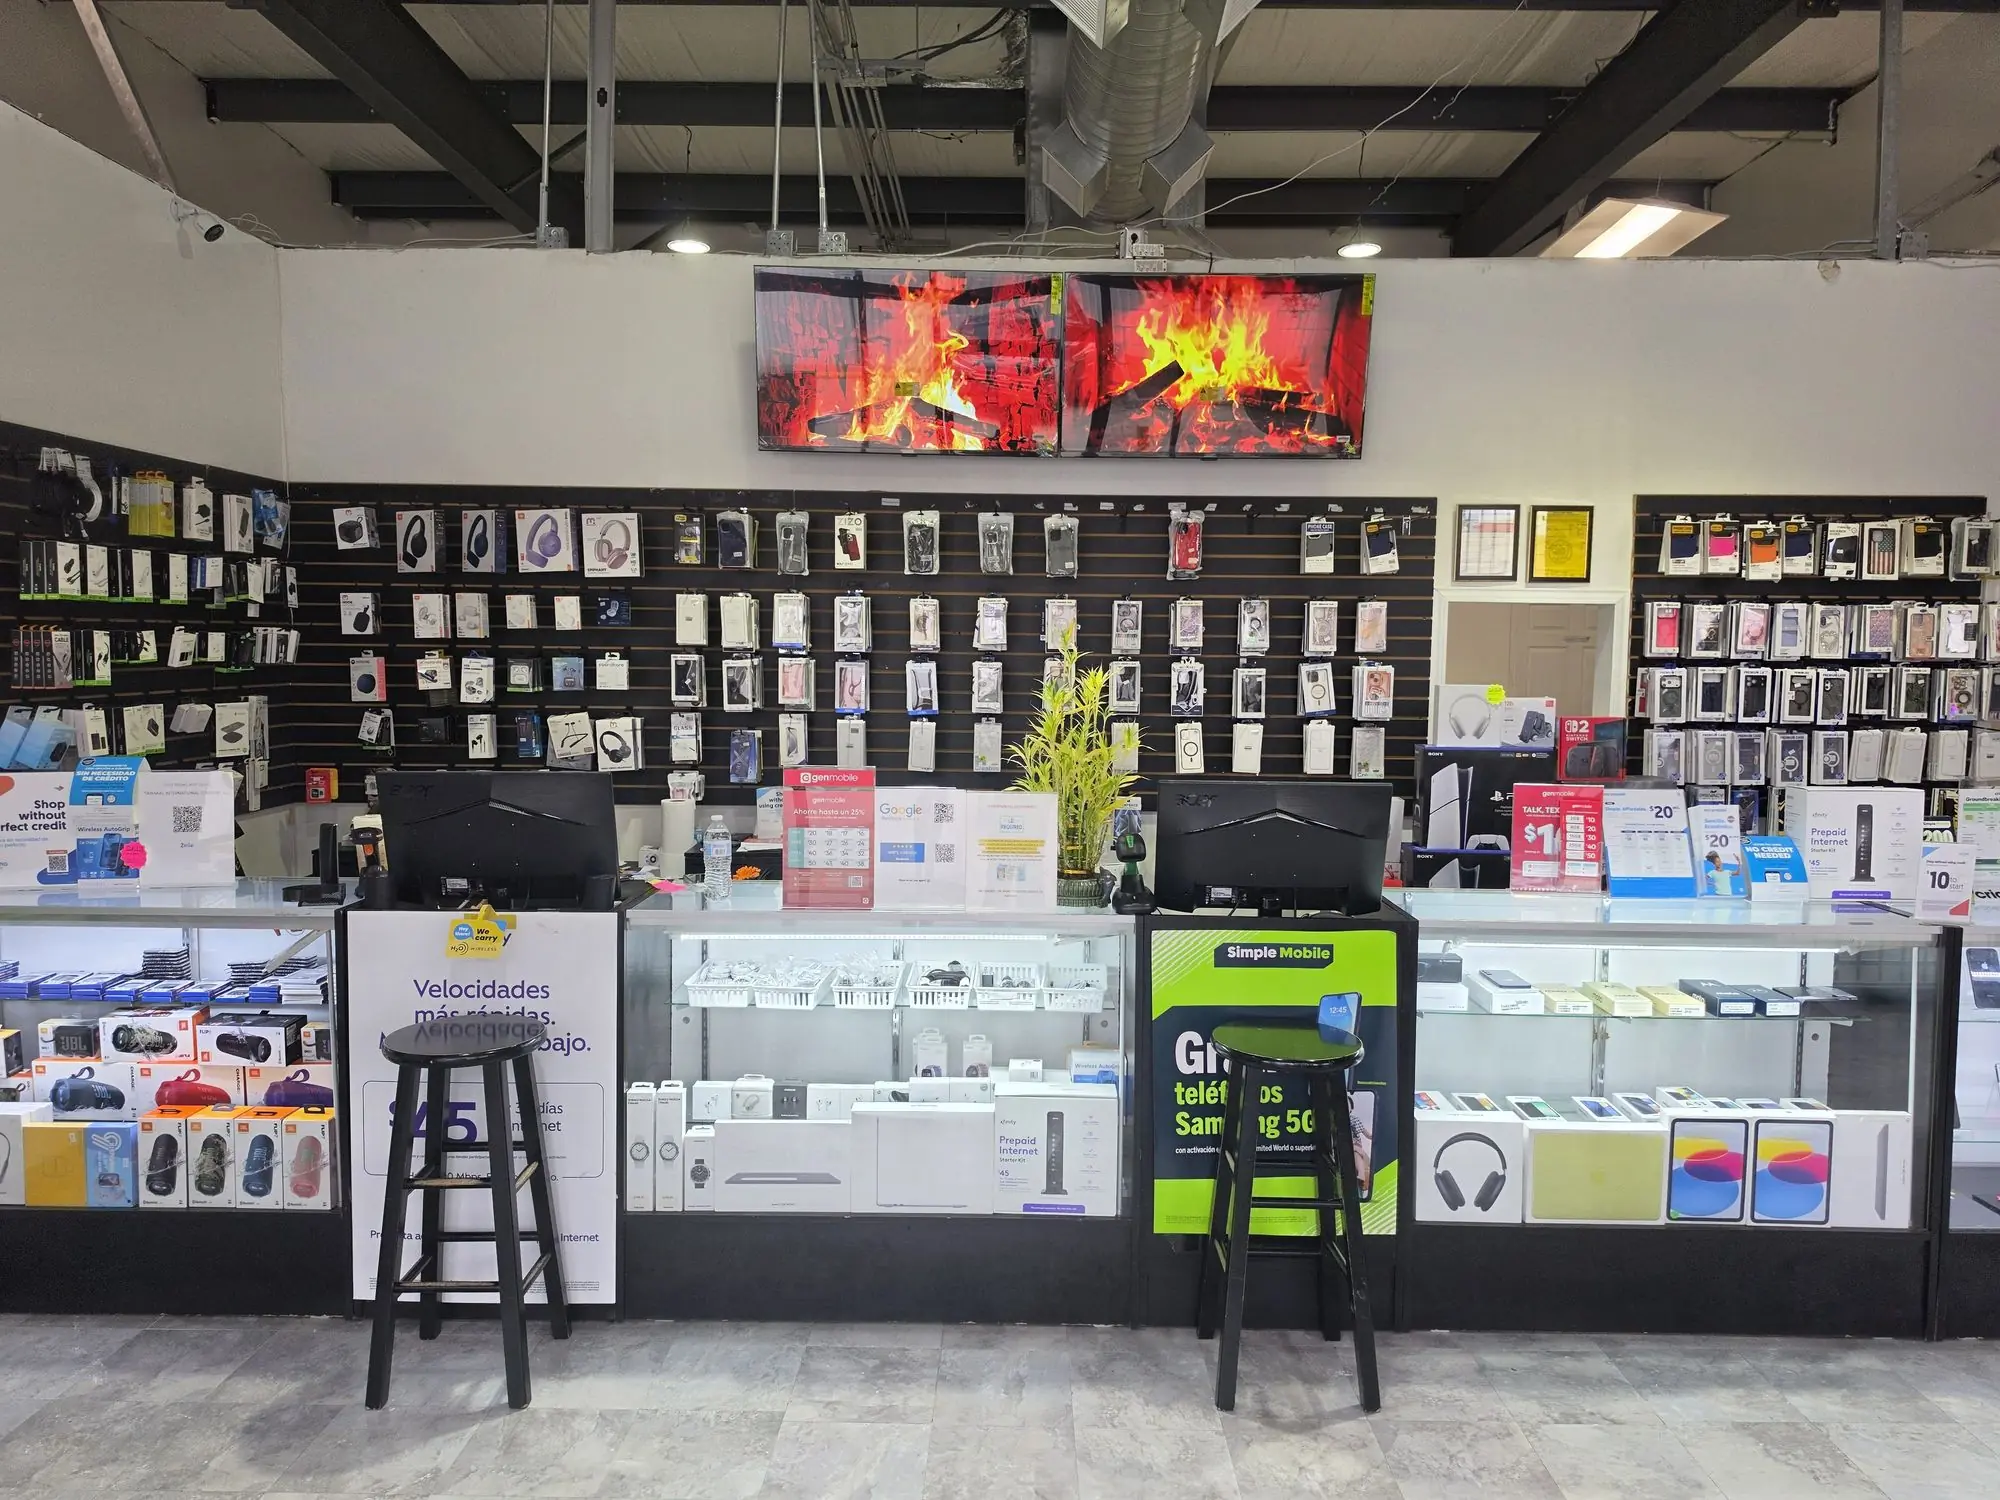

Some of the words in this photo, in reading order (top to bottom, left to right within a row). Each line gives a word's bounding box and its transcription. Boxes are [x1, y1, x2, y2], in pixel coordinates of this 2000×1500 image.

[838, 518, 862, 526] ZIZO
[1579, 720, 1589, 732] 2
[812, 774, 858, 783] genmobile
[34, 800, 65, 811] Shop
[880, 803, 922, 818] Google
[1523, 806, 1544, 814] TALK,
[1546, 806, 1560, 814] TEX
[19, 811, 66, 821] without
[1649, 806, 1673, 819] $20
[1, 822, 28, 832] rfect
[31, 821, 67, 831] credit
[1811, 828, 1847, 837] Prepaid
[1705, 834, 1729, 848] $20
[1811, 838, 1848, 846] Internet
[1926, 870, 1950, 889] $10
[1227, 946, 1276, 960] Simple
[1280, 946, 1330, 959] Mobile
[414, 979, 550, 999] Velocidades
[60, 1036, 86, 1051] JBL
[92, 1084, 112, 1099] JBL
[1175, 1080, 1284, 1105] teléfos
[539, 1101, 563, 1115] días
[1175, 1111, 1280, 1139] Samng
[999, 1135, 1036, 1147] Prepaid
[999, 1147, 1038, 1155] Internet
[561, 1232, 599, 1242] Internet
